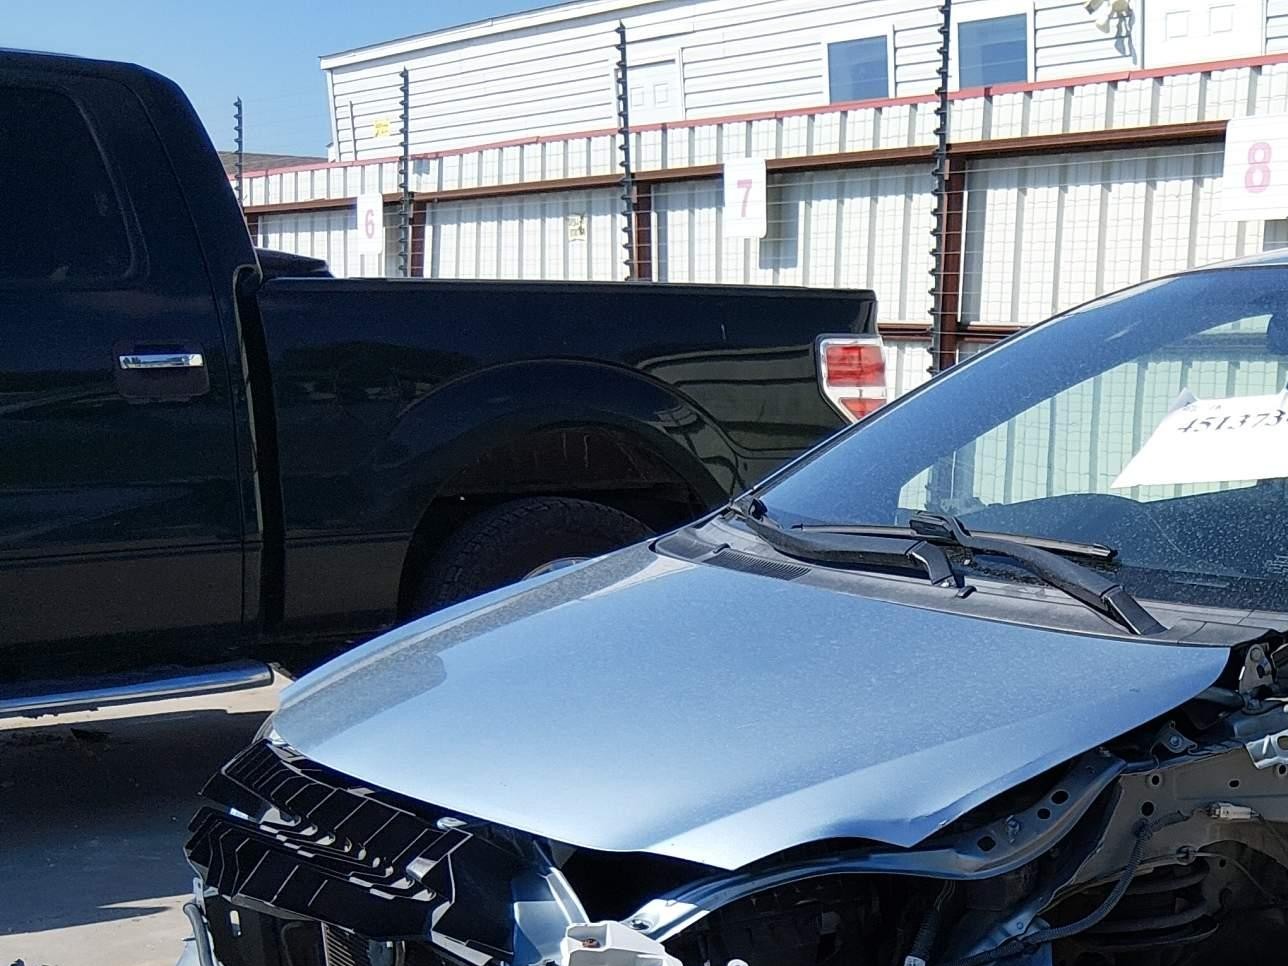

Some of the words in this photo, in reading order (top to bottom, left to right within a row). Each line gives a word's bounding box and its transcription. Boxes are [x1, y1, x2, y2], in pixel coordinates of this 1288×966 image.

[1244, 141, 1272, 193] 8
[736, 179, 753, 218] 7
[364, 208, 375, 240] 6
